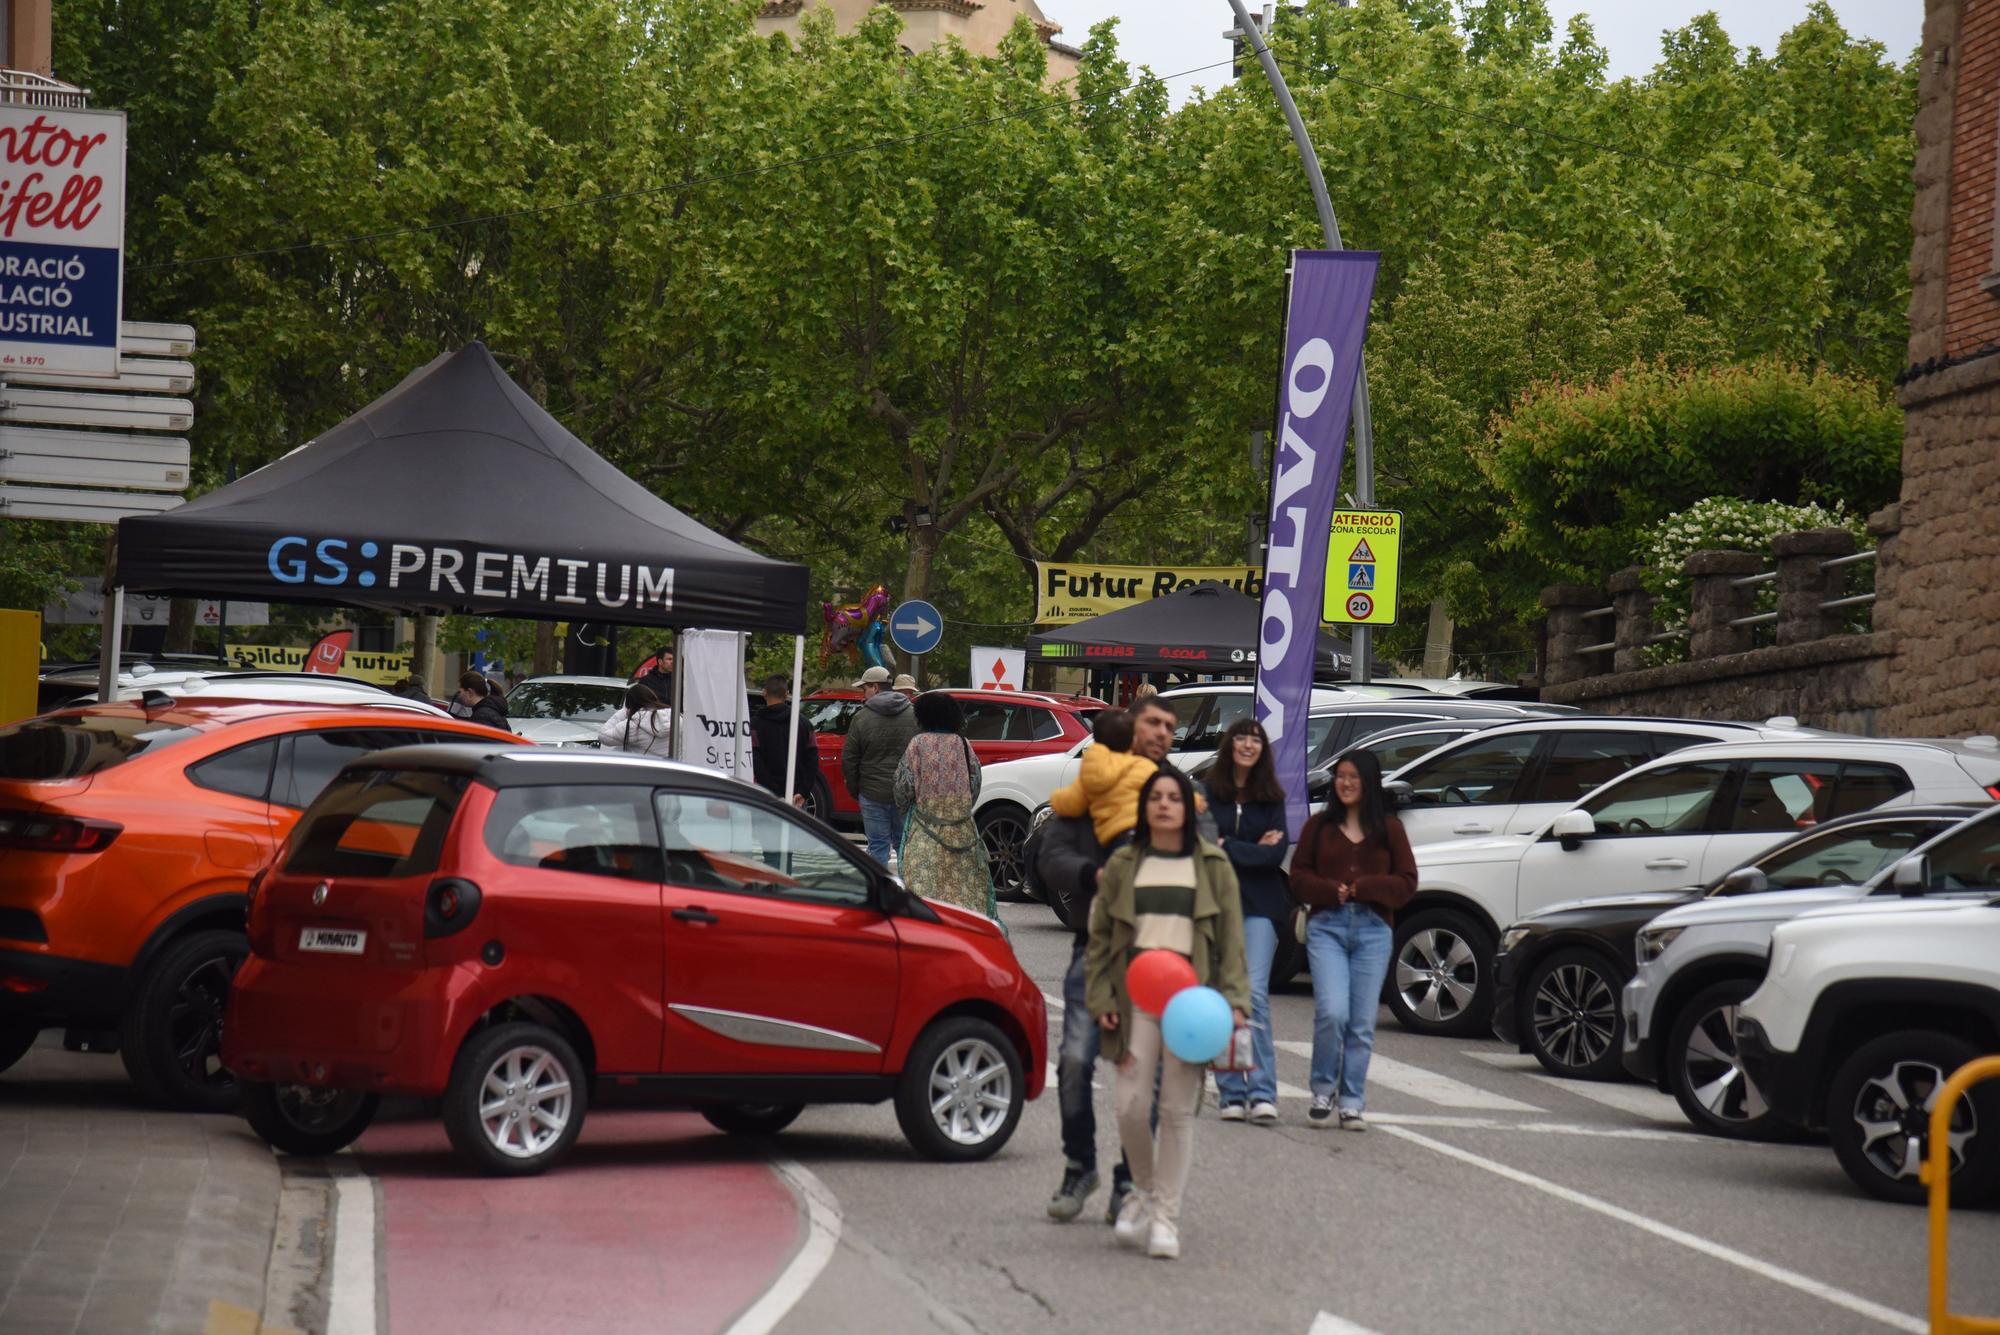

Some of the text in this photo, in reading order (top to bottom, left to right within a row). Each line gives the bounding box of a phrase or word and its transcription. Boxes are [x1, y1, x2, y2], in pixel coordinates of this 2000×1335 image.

[1334, 514, 1394, 526] ATENCIÓ
[1330, 525, 1397, 535] ZONA ESCOLAR
[1256, 337, 1335, 744] VOLVO
[1047, 568, 1144, 599] Futur
[1352, 601, 1369, 611] 20
